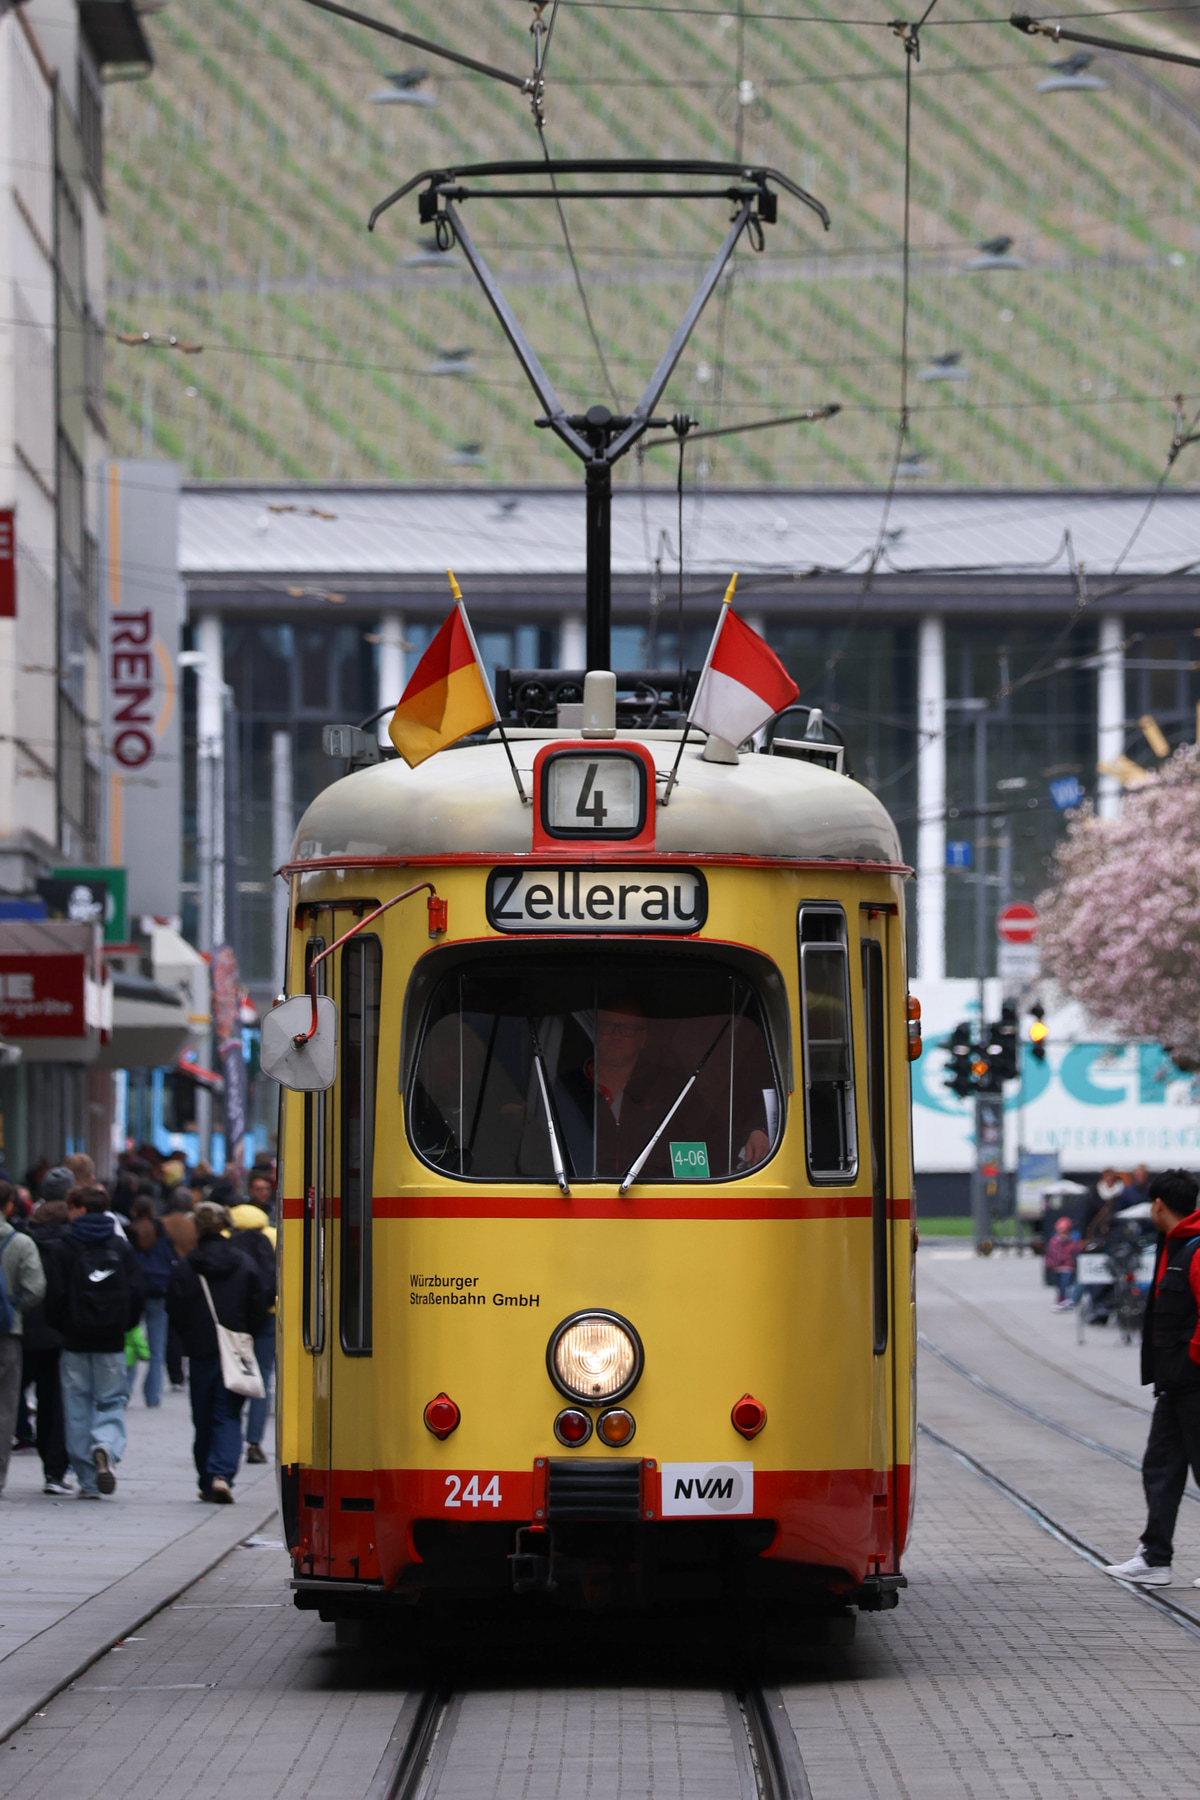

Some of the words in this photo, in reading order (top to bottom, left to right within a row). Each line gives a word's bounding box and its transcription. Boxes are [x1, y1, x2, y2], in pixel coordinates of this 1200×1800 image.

[111, 607, 154, 769] RENO
[576, 763, 607, 826] 4
[493, 869, 700, 920] Zellerau
[674, 1150, 706, 1166] 4-06
[410, 1274, 479, 1290] Würzburger
[410, 1292, 486, 1305] Straßenbahn
[492, 1293, 540, 1307] GmbH
[444, 1475, 502, 1507] 244
[674, 1478, 734, 1499] NVM
